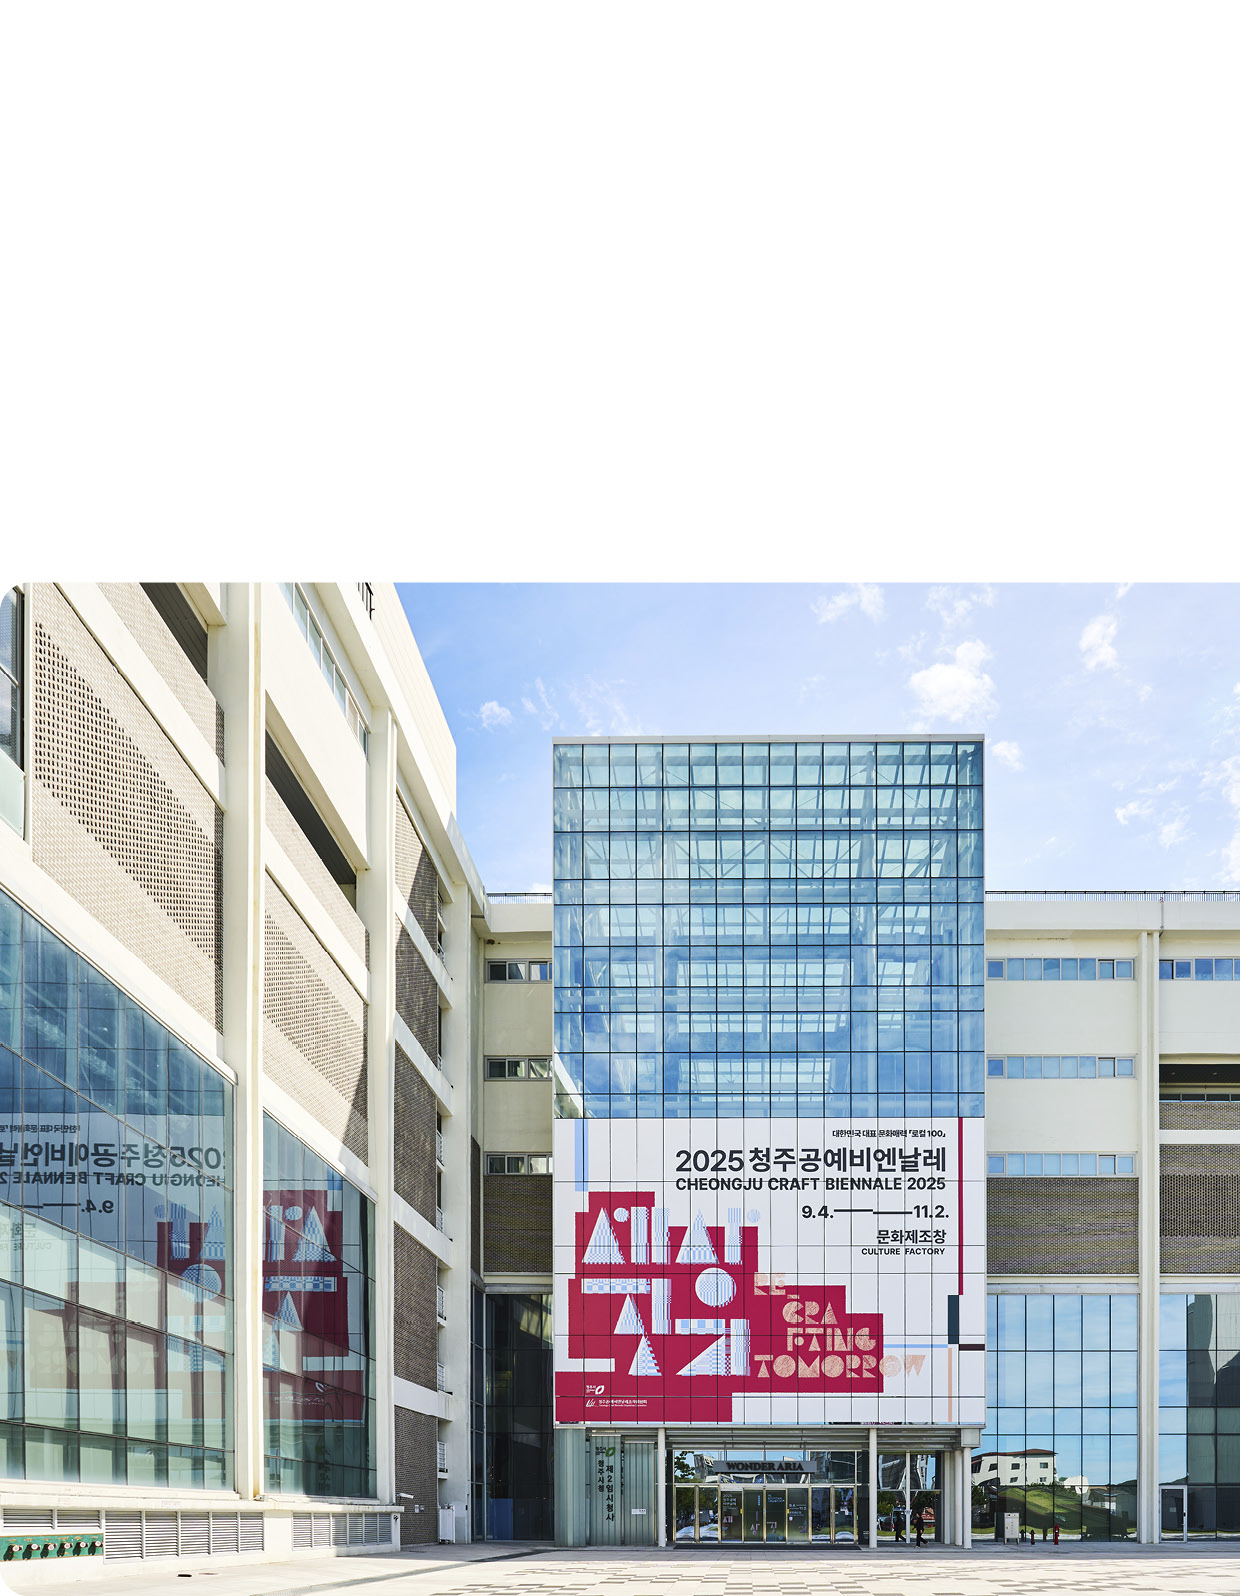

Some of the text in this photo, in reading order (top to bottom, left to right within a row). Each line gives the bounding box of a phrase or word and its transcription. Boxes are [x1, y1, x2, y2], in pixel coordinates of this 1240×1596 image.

[832, 1130, 861, 1138] 대한민국
[862, 1130, 876, 1138] 대표
[878, 1130, 908, 1138] 문화매력
[676, 1147, 946, 1172] 2025 청주공예비엔날레
[676, 1177, 946, 1190] CHEONGJU CRAFT BIENNALE 2025
[876, 1229, 946, 1244] 문화제조창
[754, 1354, 926, 1378] TOMORROW
[726, 1462, 804, 1471] WONDER ARIA
